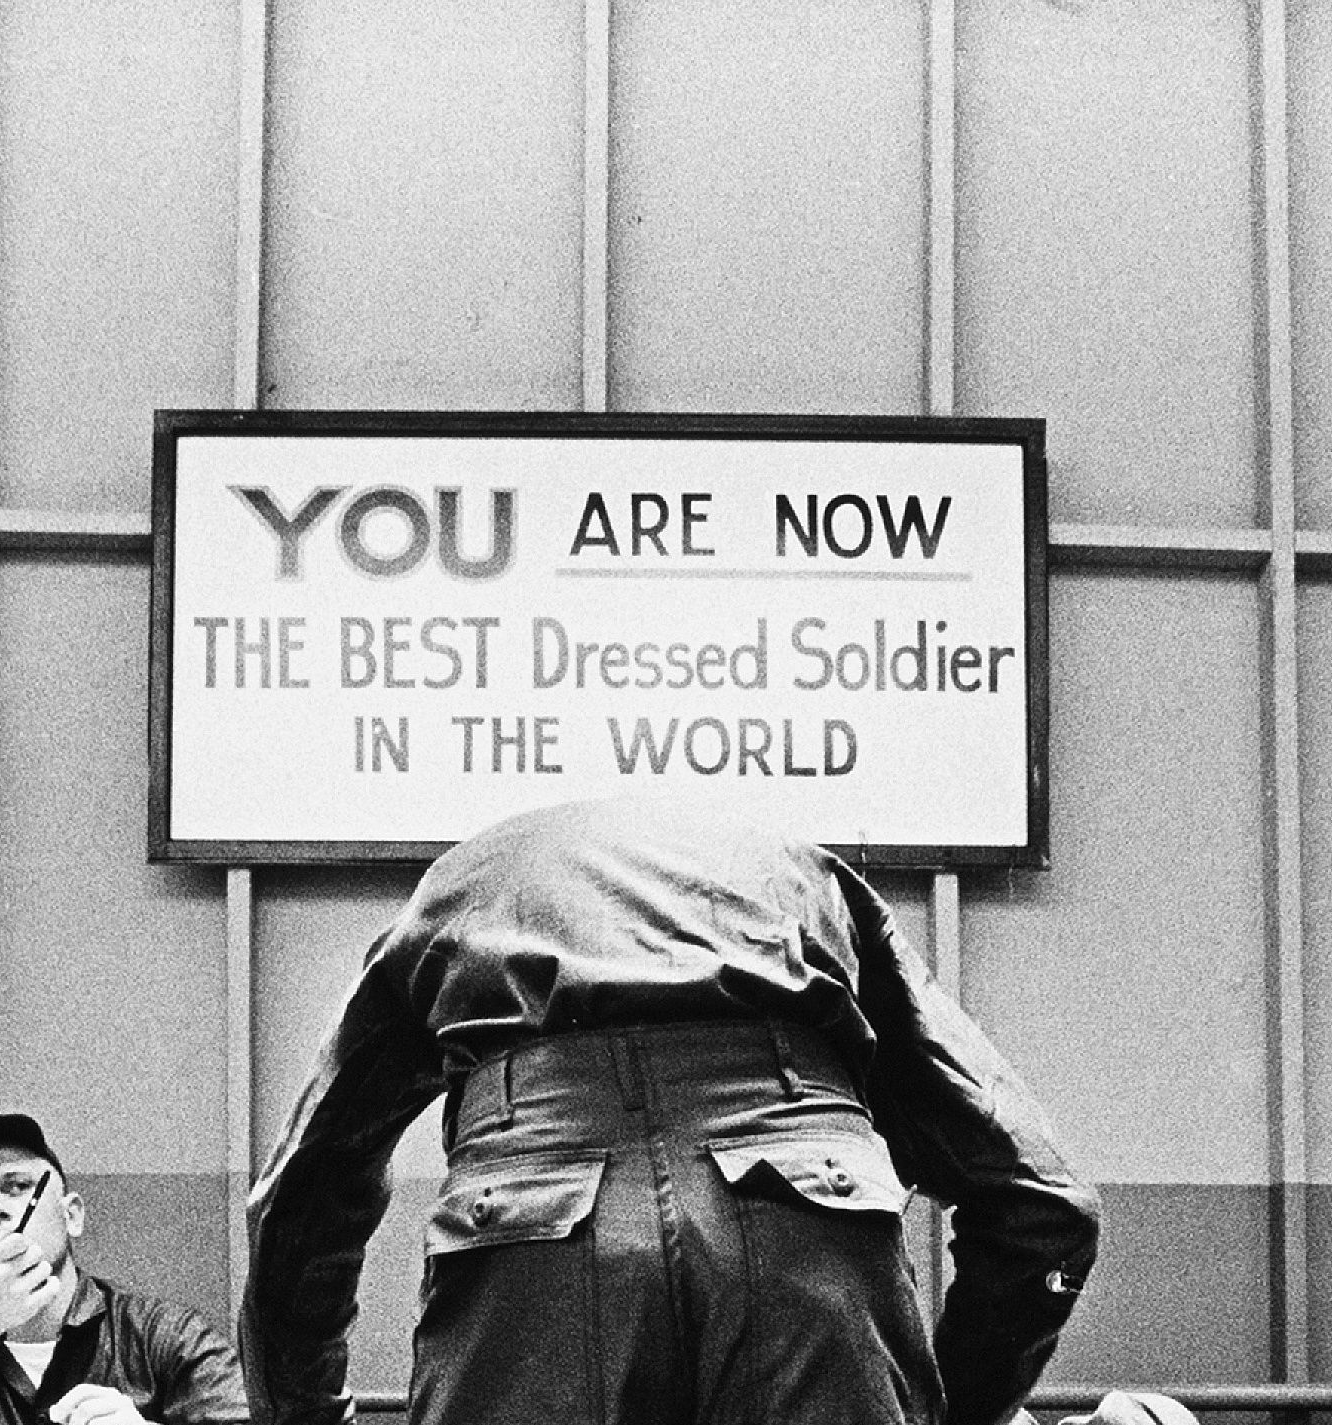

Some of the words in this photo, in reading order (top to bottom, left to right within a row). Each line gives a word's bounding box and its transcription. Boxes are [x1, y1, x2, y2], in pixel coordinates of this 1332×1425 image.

[227, 485, 517, 580] YOU
[569, 491, 716, 557] ARE
[774, 493, 953, 560] NOW
[194, 617, 309, 688] THE
[341, 617, 500, 689] BEST
[533, 618, 769, 689] Dressed
[792, 618, 1016, 694] Soldier
[355, 717, 408, 773] IN
[452, 717, 563, 774] THE
[608, 717, 858, 778] WORLD
